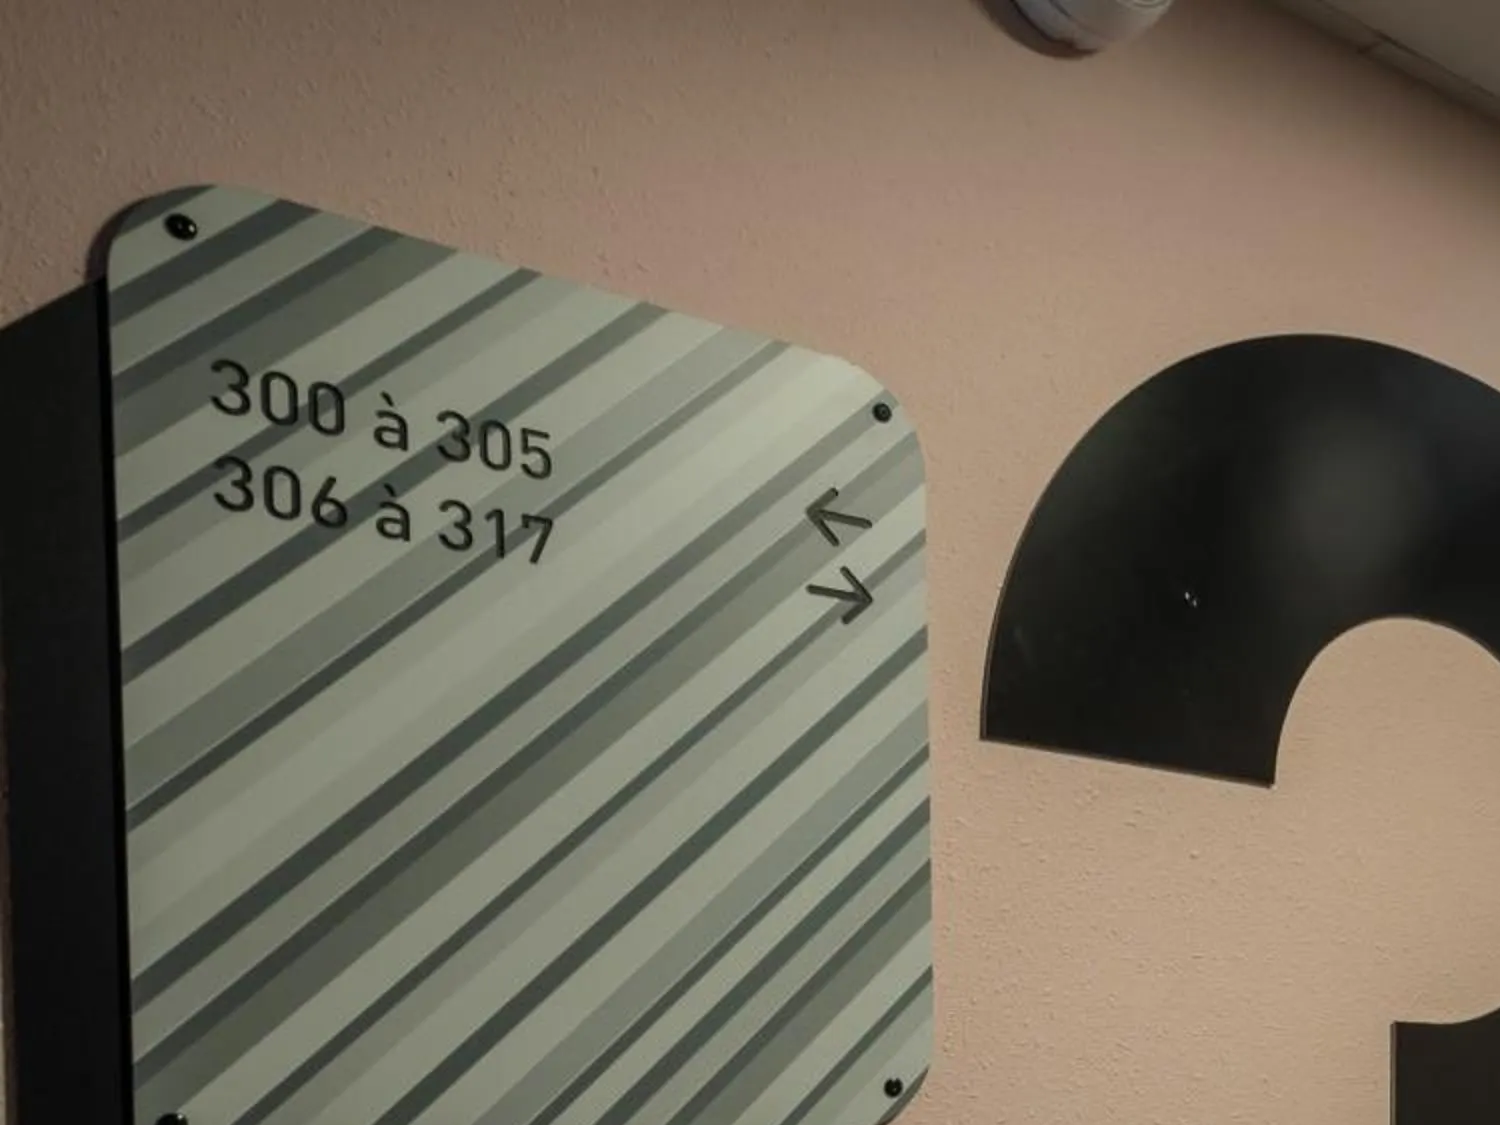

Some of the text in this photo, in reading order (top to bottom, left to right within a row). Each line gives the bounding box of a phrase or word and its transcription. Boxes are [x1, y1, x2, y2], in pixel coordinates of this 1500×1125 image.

[210, 359, 552, 479] 300 à 305
[213, 455, 554, 564] 306 à 317
